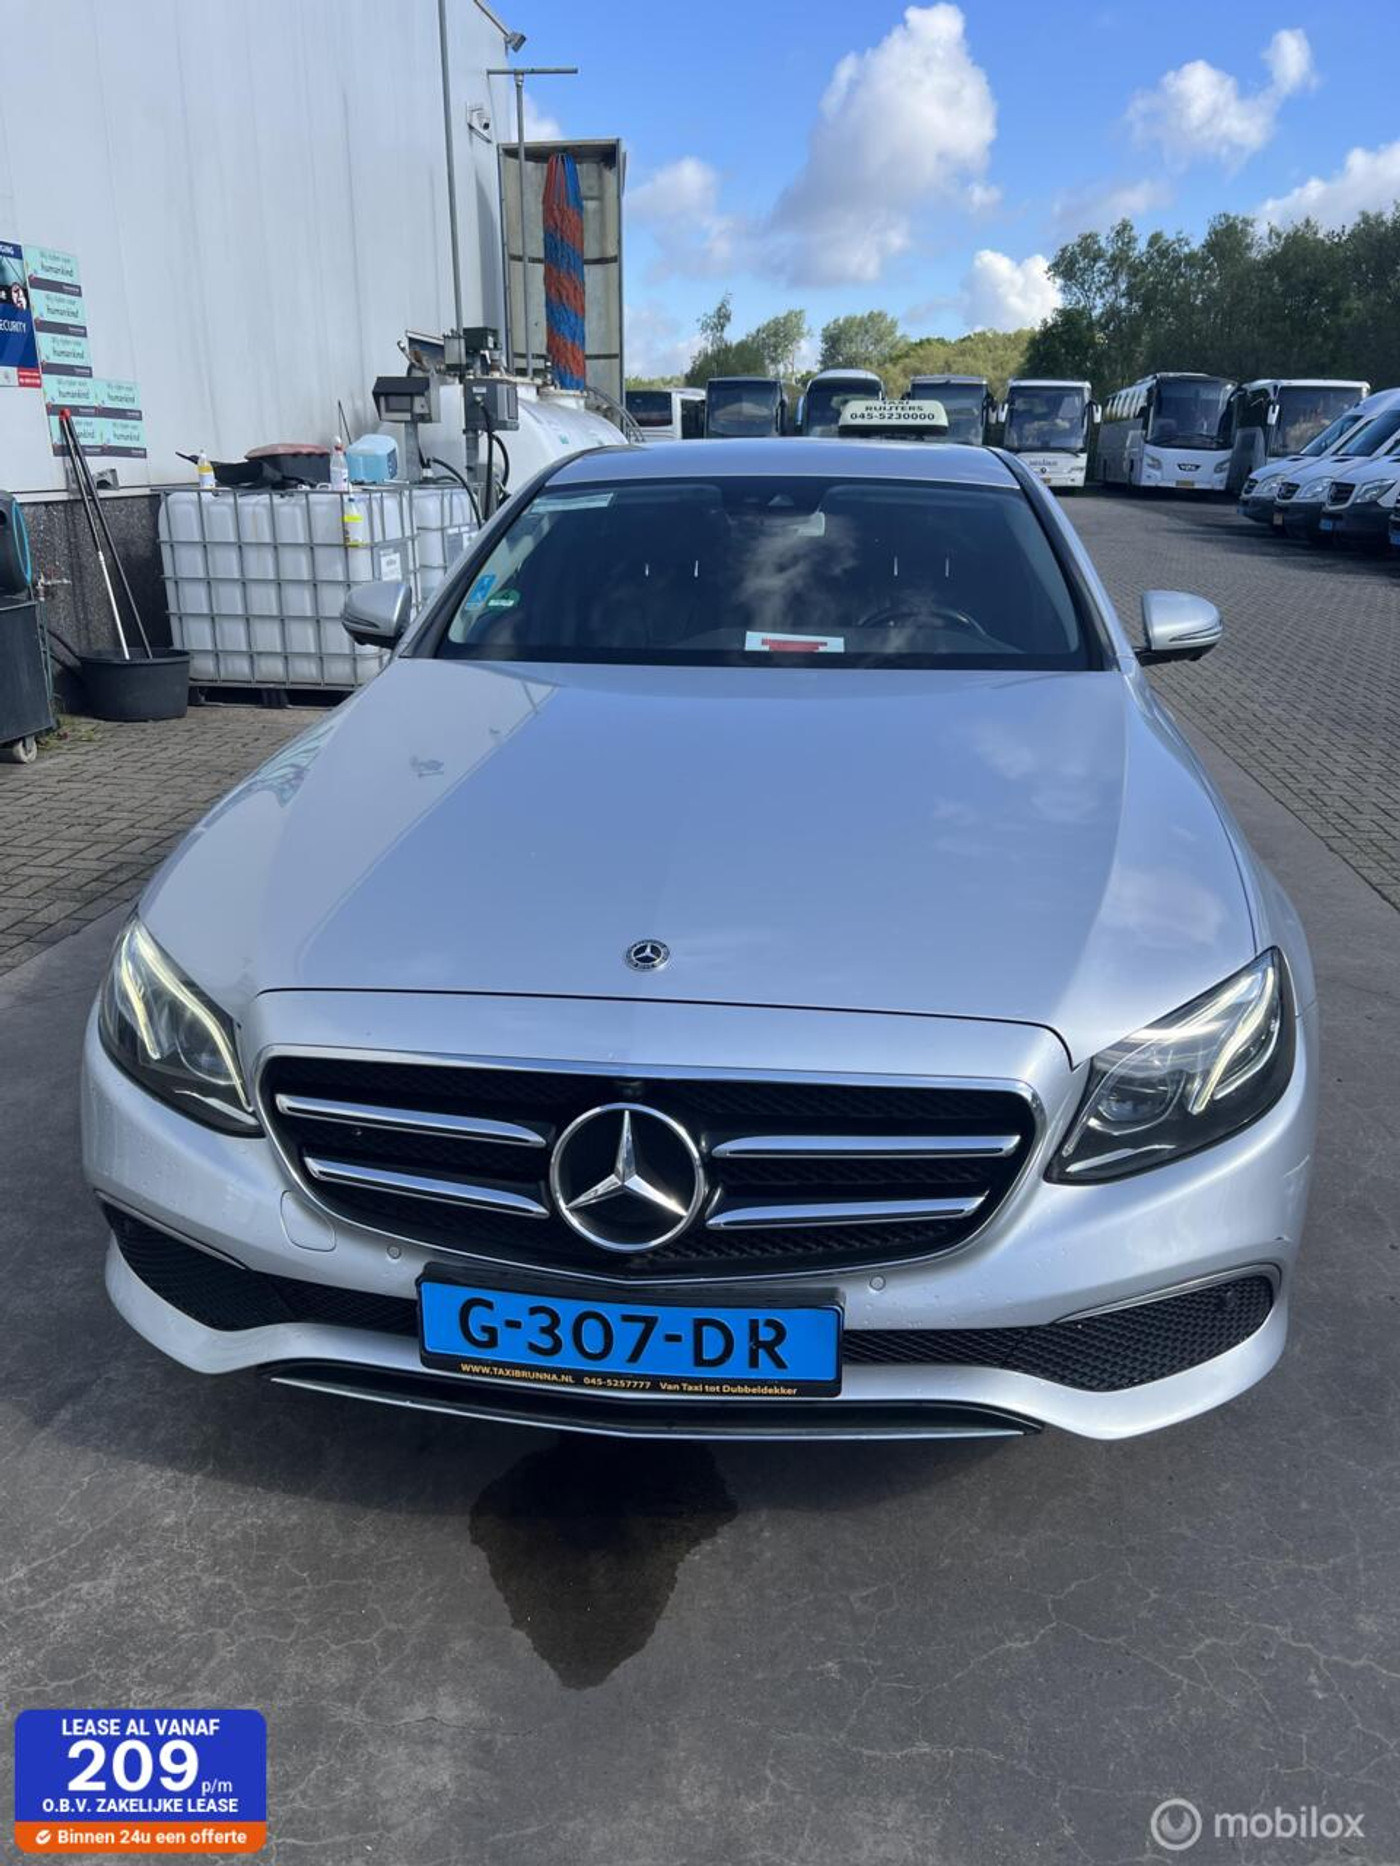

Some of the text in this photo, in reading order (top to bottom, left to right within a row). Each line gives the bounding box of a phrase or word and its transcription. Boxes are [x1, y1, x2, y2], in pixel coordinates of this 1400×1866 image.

[458, 1297, 789, 1371] G-307-DR
[460, 1363, 798, 1396] WWW.TAXIBRUNNA.NL 045-5257777 Van Taxi tot Dubbeldekker
